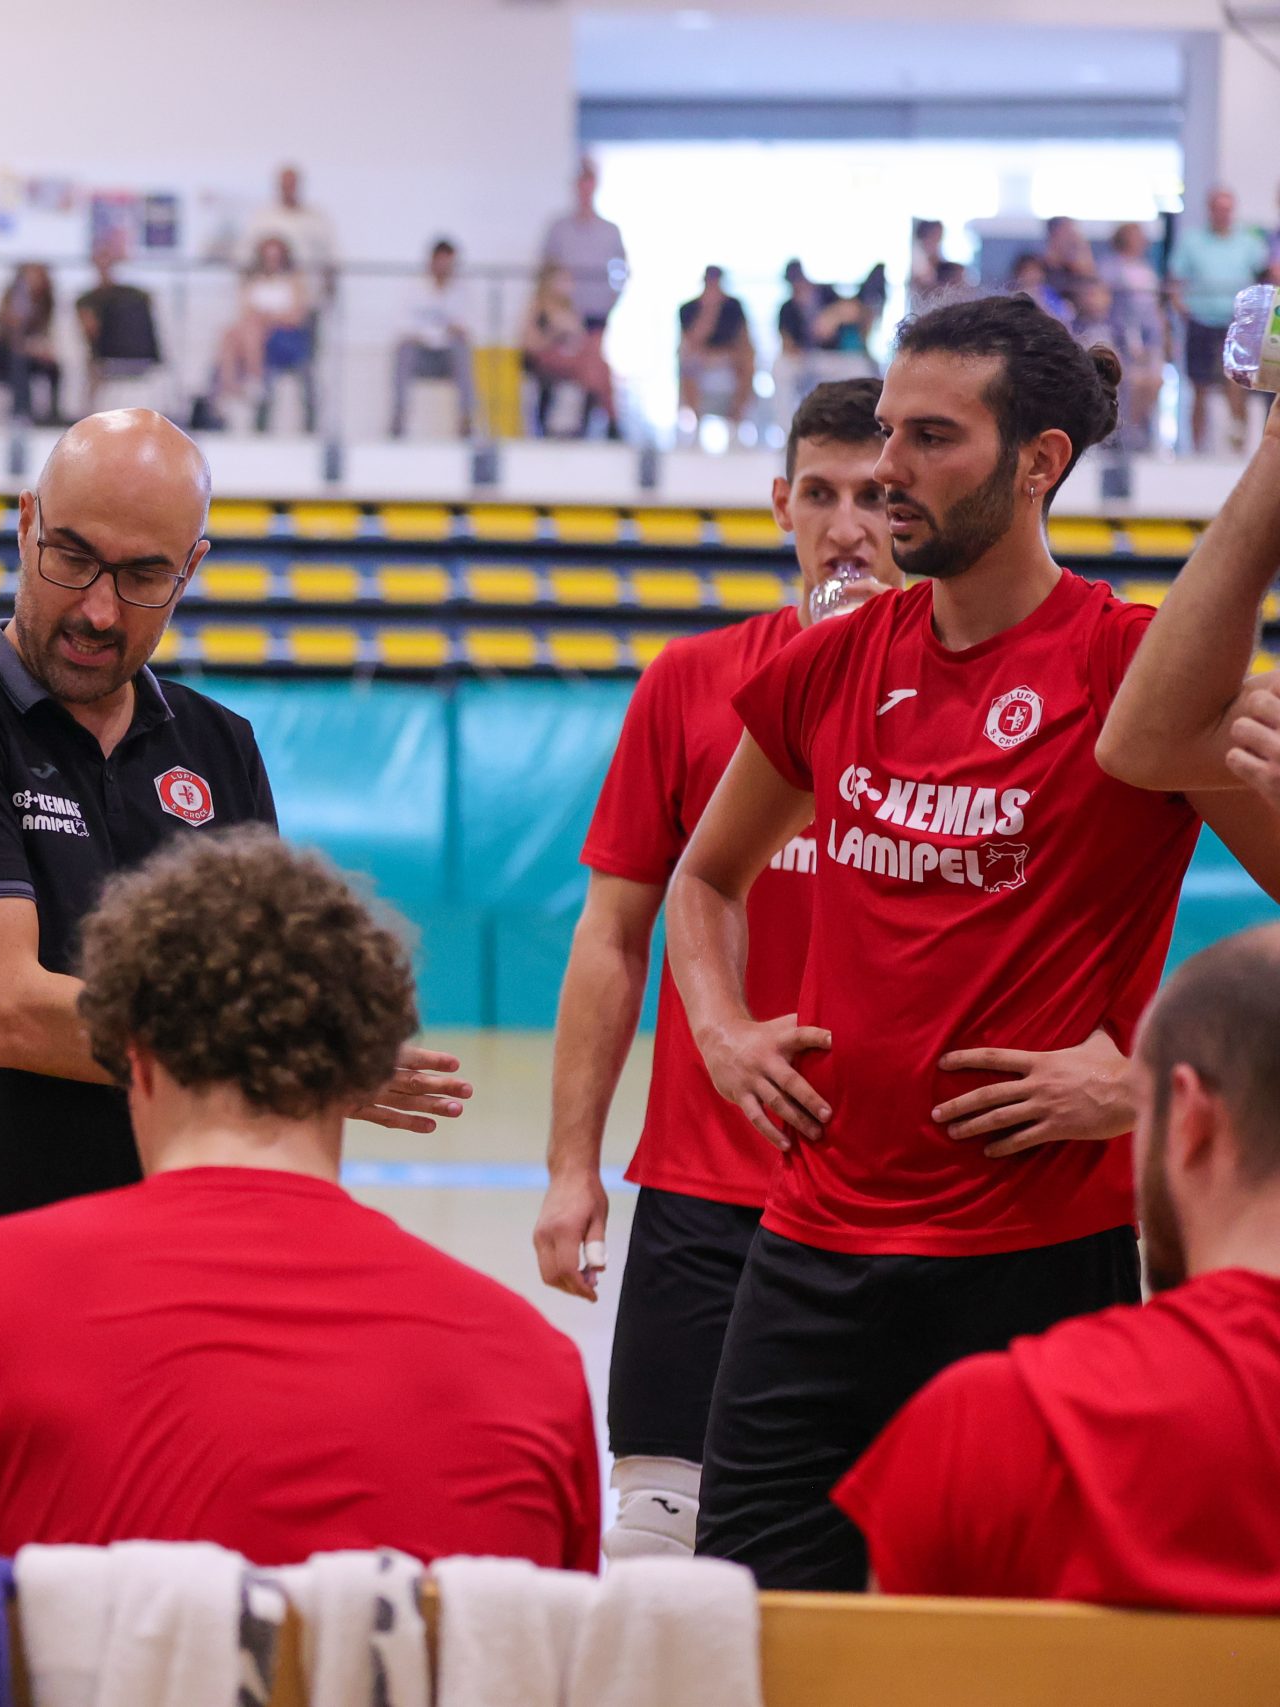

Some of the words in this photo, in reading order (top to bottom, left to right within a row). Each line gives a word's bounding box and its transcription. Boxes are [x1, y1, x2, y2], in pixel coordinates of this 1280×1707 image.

[1010, 691, 1035, 702] LUPI
[990, 728, 997, 739] S.
[170, 773, 193, 781] LUPI
[37, 792, 82, 819] KEMAS
[171, 803, 179, 812] S.
[183, 808, 209, 819] CROCE
[874, 778, 1031, 836] KEMAS
[22, 814, 78, 835] AMIPEL
[827, 818, 984, 887] LAMIPEL
